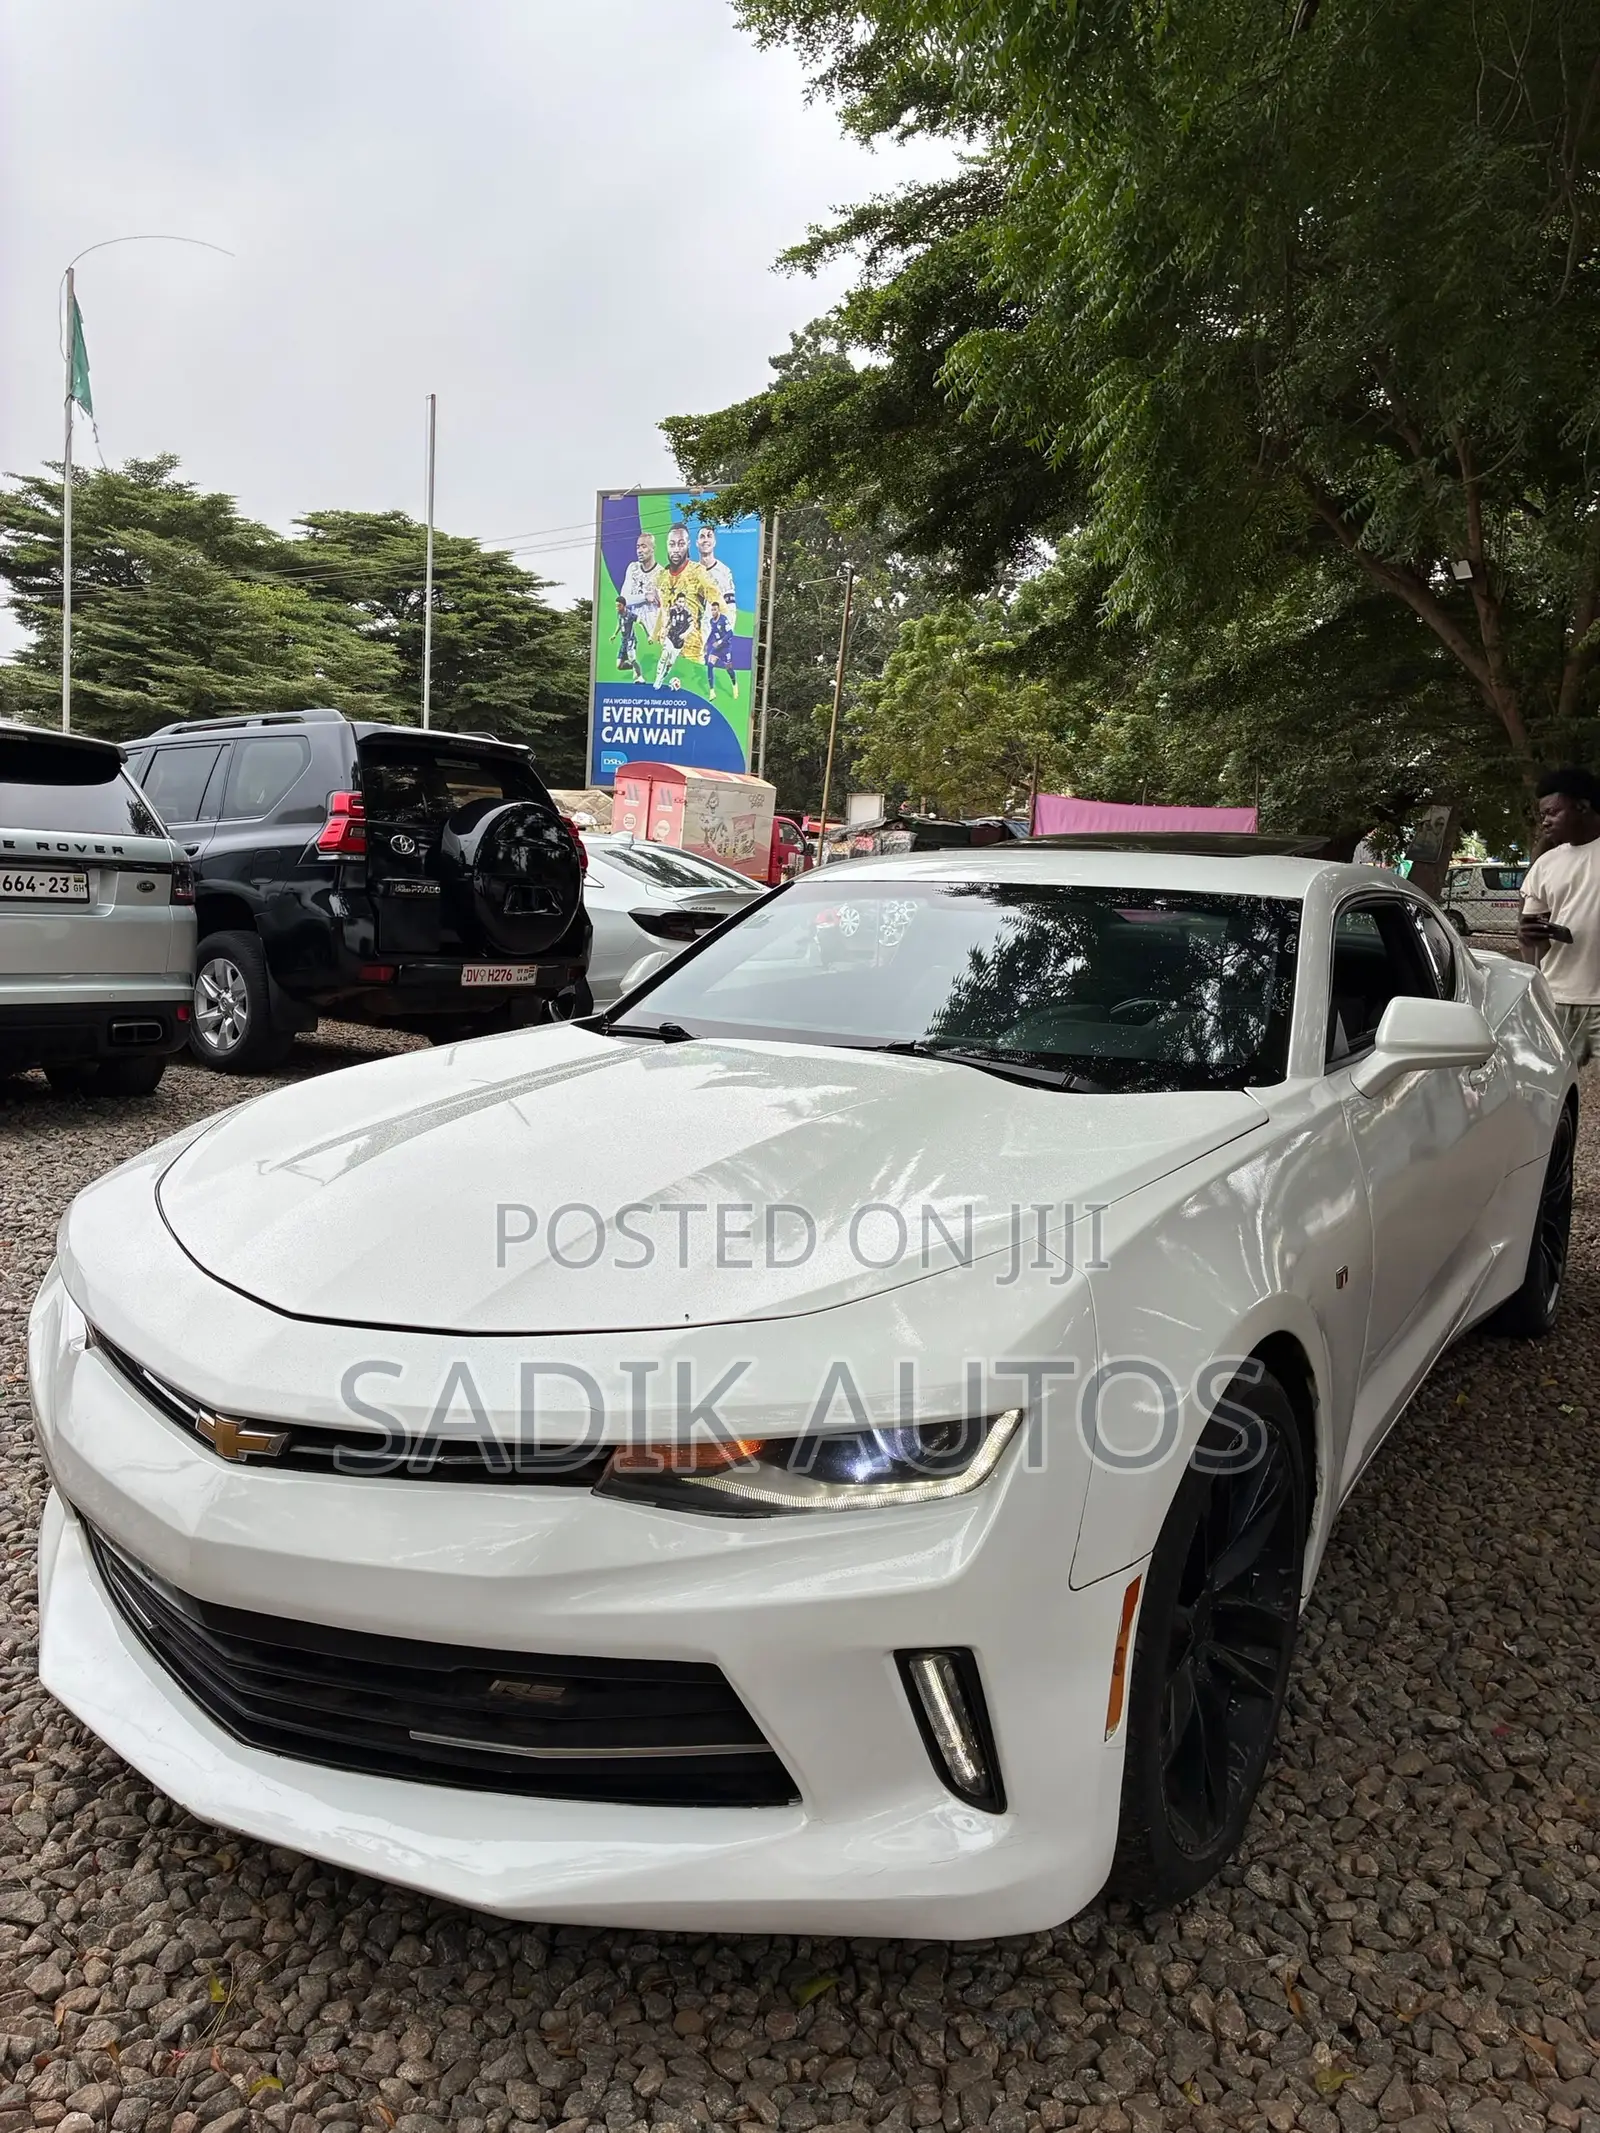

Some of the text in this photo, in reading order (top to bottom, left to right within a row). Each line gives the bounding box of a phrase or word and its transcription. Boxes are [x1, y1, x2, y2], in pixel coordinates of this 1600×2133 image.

[602, 706, 711, 726] EVERYTHING
[601, 726, 686, 746] CAN WAIT
[36, 841, 125, 855] ROVER
[2, 875, 70, 893] 664-23
[73, 884, 85, 893] GH
